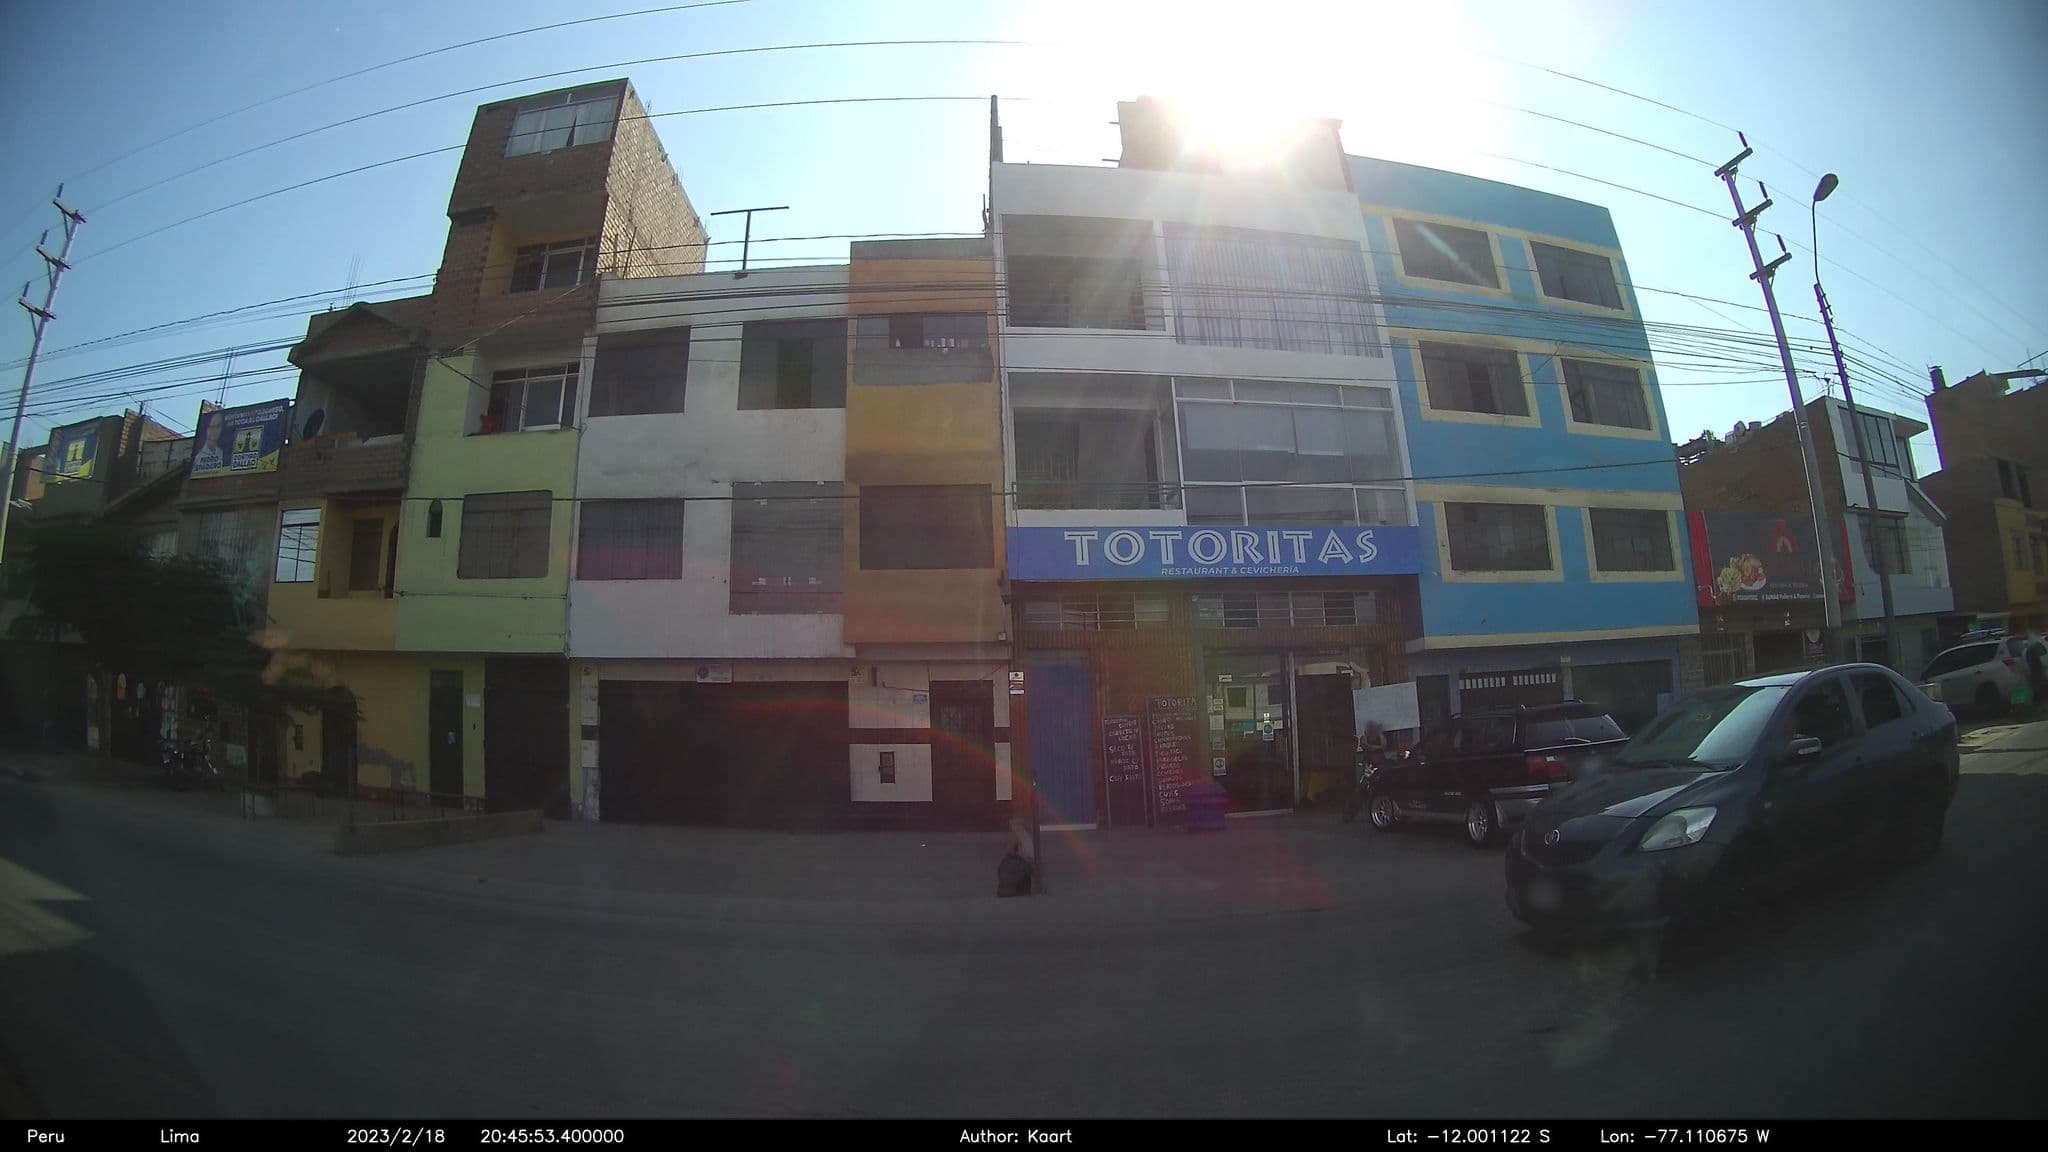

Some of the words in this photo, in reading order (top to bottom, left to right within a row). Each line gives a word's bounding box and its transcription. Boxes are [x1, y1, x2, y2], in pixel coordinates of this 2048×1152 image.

[1064, 530, 1377, 565] TOTORITAS
[1161, 567, 1229, 576] RESTAURANT
[1231, 567, 1238, 575] &
